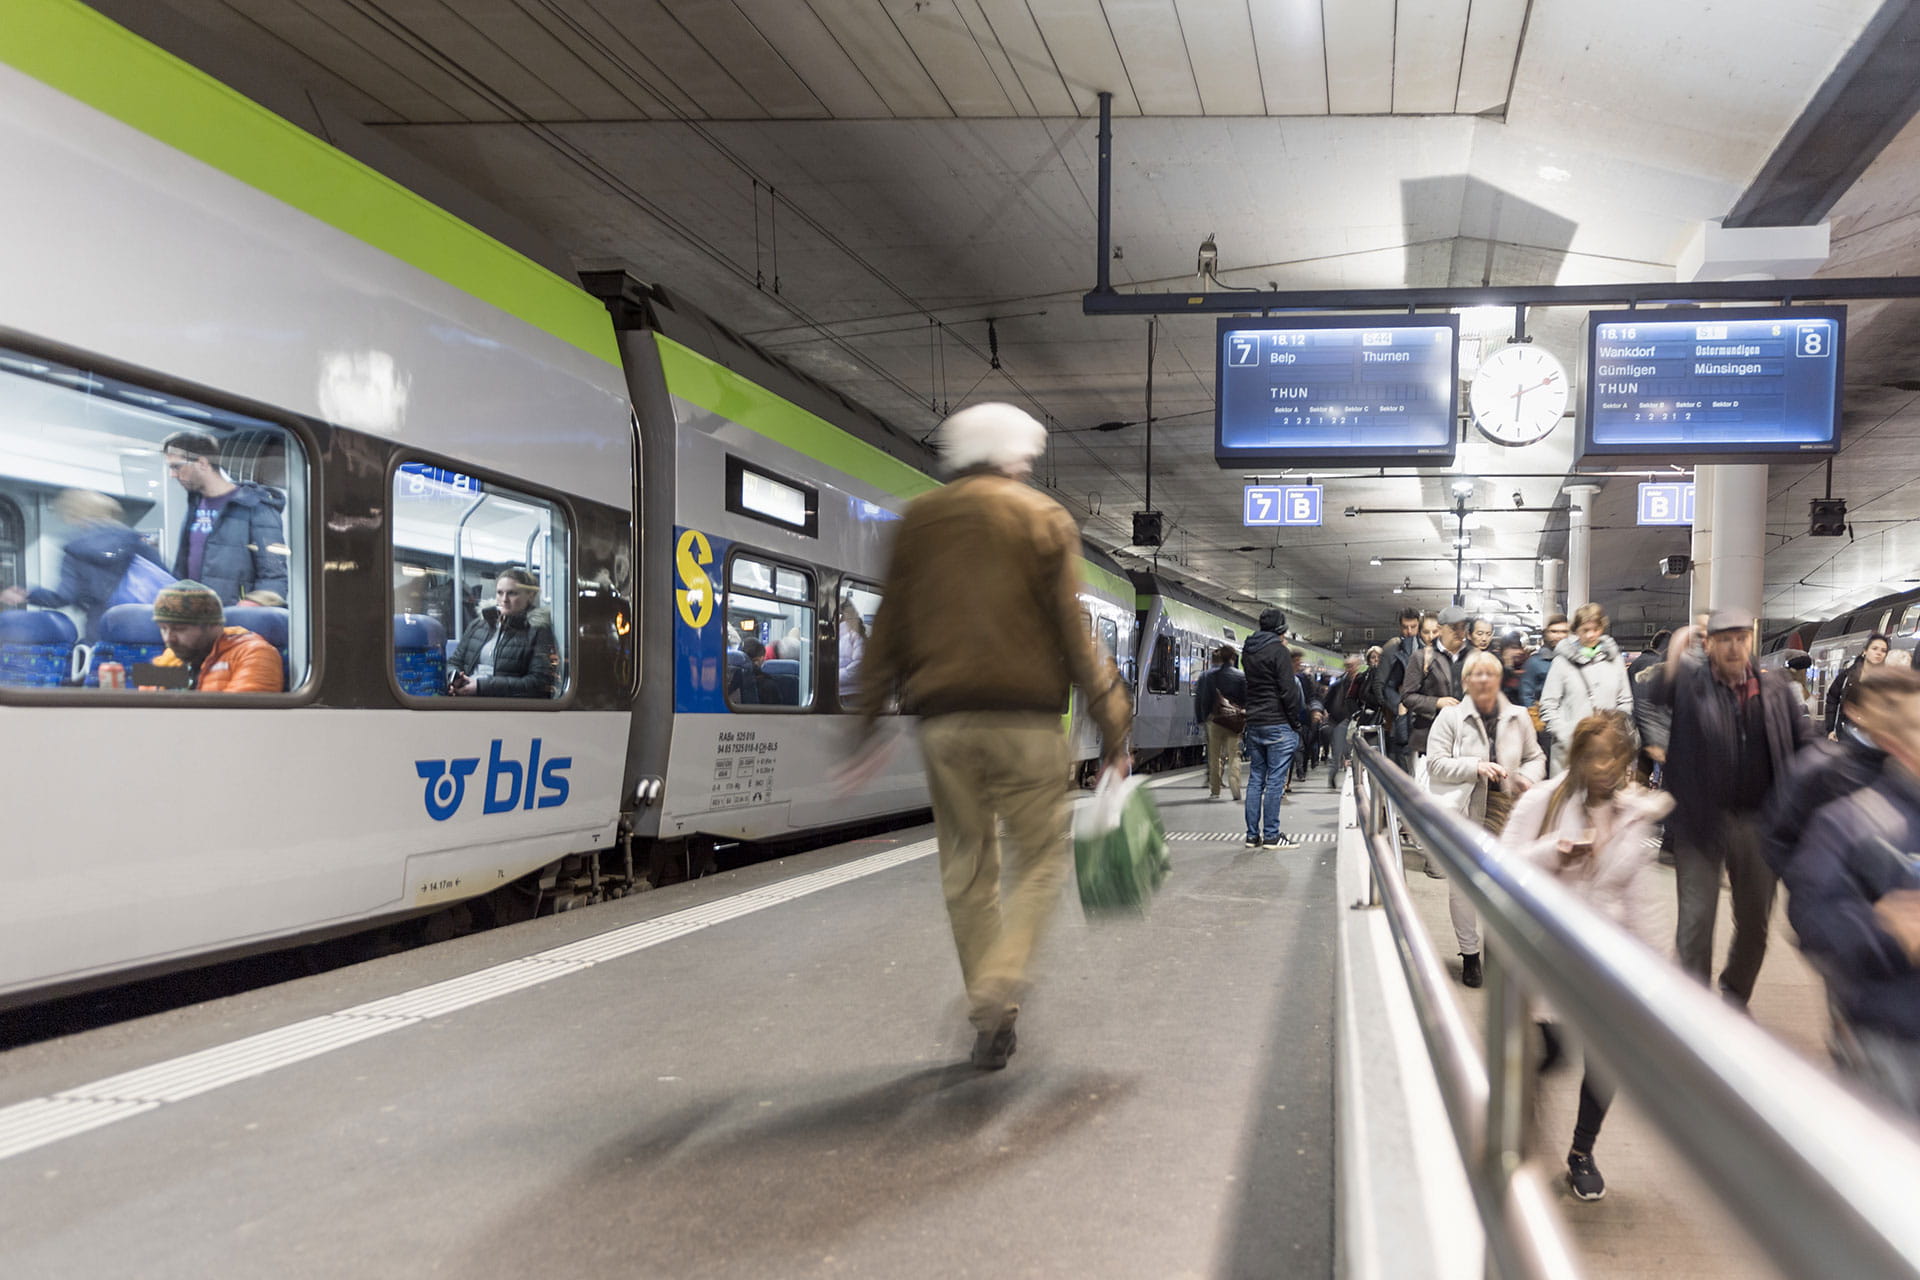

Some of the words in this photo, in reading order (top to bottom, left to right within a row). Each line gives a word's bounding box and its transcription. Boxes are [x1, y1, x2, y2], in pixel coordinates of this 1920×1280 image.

[1804, 333, 1821, 354] 8
[1237, 343, 1251, 364] 7
[1363, 351, 1410, 362] Thurnen
[1600, 346, 1655, 357] Wankdorf
[1695, 344, 1760, 357] Ostermundigen
[1270, 353, 1296, 365] Belp
[1598, 364, 1656, 377] Gümligen
[1694, 363, 1762, 375] Münsingen
[1270, 387, 1309, 398] THUN
[1598, 383, 1638, 394] THUN
[1256, 498, 1272, 519] 7
[1294, 498, 1310, 519] B
[1650, 496, 1669, 518] B
[483, 738, 572, 815] bls
